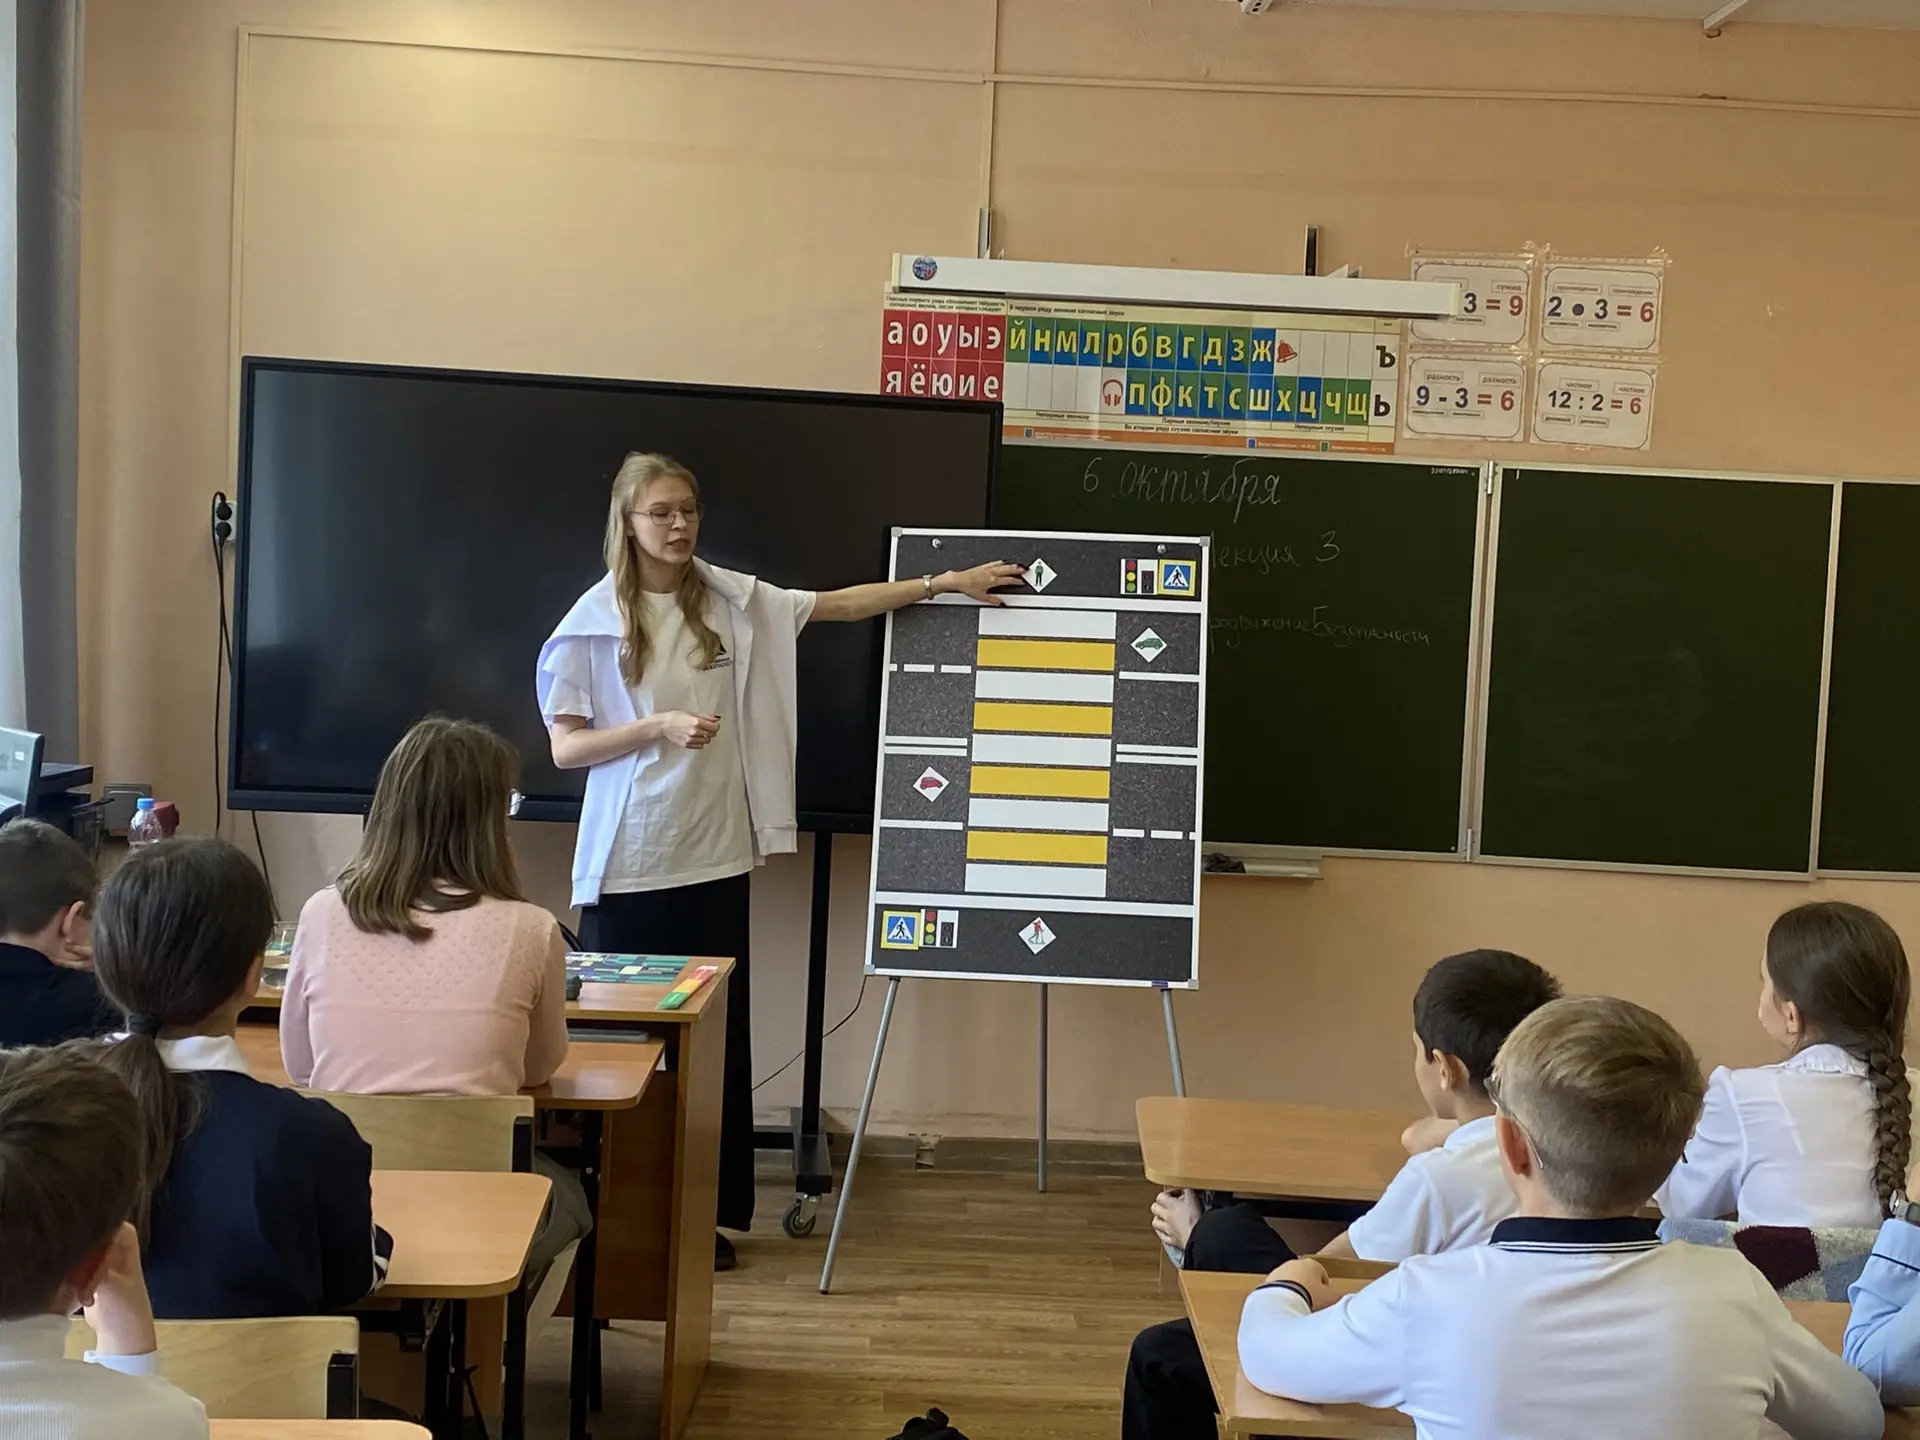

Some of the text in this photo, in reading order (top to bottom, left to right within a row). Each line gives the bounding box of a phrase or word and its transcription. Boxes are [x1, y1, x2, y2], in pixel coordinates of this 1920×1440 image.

[1463, 292, 1477, 313] 3
[1509, 295, 1523, 316] 9
[1547, 296, 1562, 317] 2
[1594, 298, 1608, 320] 3
[1640, 302, 1654, 323] 6
[1426, 373, 1460, 382] разность
[1482, 377, 1517, 385] разность
[1416, 385, 1430, 406] 9
[1455, 387, 1468, 408] 3
[1500, 390, 1514, 411] 6
[1548, 390, 1572, 409] 12
[1591, 394, 1604, 411] 2
[1630, 397, 1641, 415] 6
[1083, 457, 1103, 492] 6
[1315, 530, 1341, 562] 3
